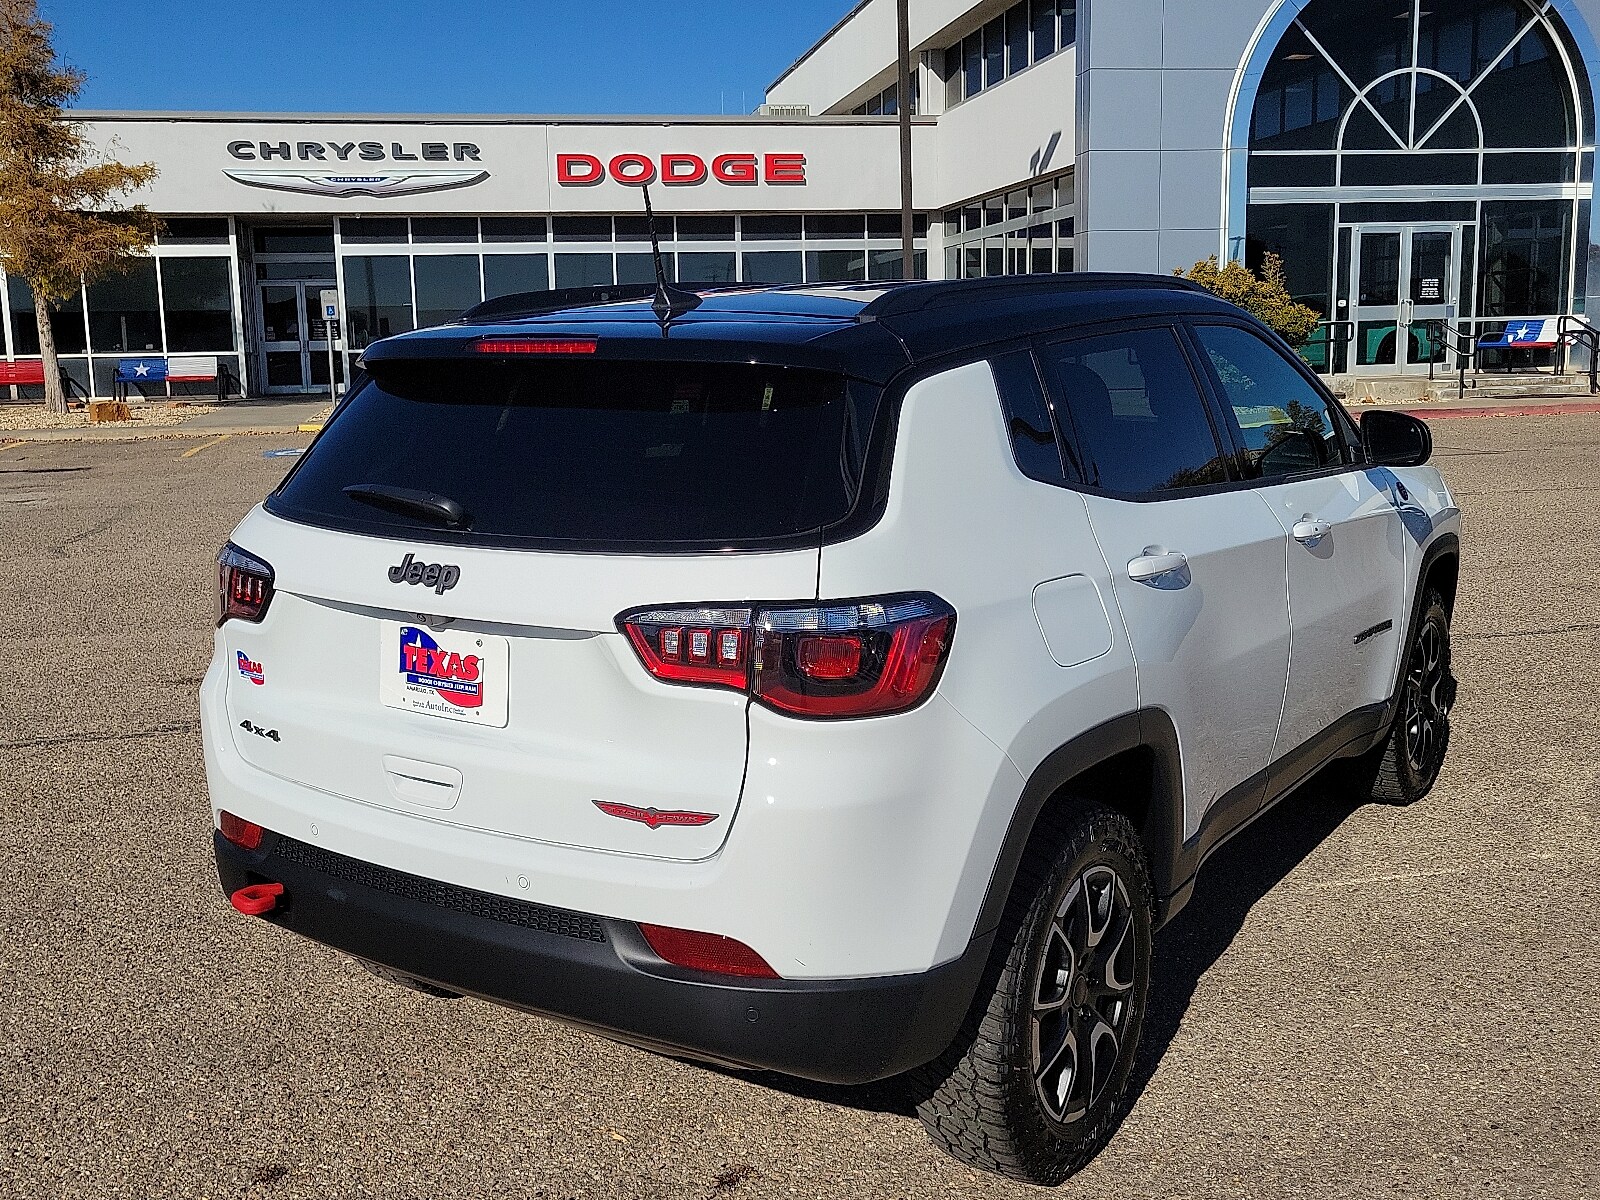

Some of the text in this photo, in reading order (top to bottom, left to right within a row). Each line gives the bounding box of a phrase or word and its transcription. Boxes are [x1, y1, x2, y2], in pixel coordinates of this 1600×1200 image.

[227, 141, 483, 161] CHRYSLER
[556, 153, 807, 187] DODGE
[387, 553, 461, 596] Jeep
[404, 644, 480, 681] TEXAS
